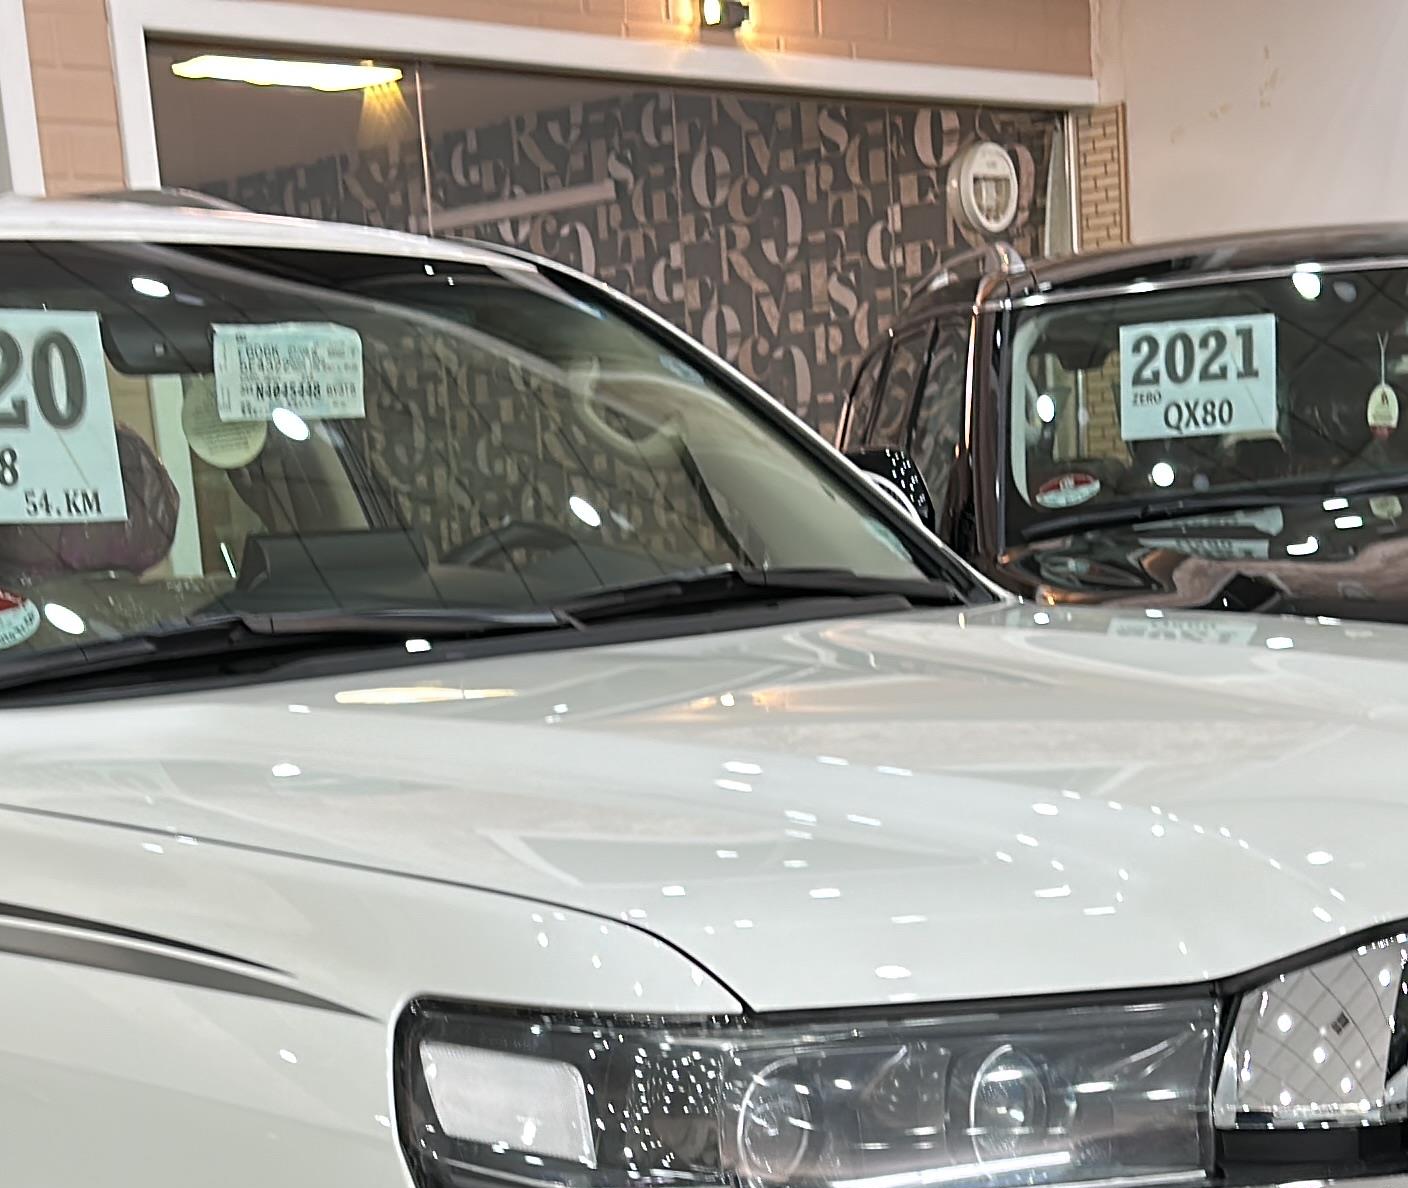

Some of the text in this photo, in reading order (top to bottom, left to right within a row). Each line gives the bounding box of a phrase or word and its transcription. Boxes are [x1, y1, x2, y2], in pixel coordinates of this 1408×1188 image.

[1131, 324, 1260, 386] 2021
[1133, 391, 1161, 407] ZERO
[1163, 399, 1234, 434] QX80
